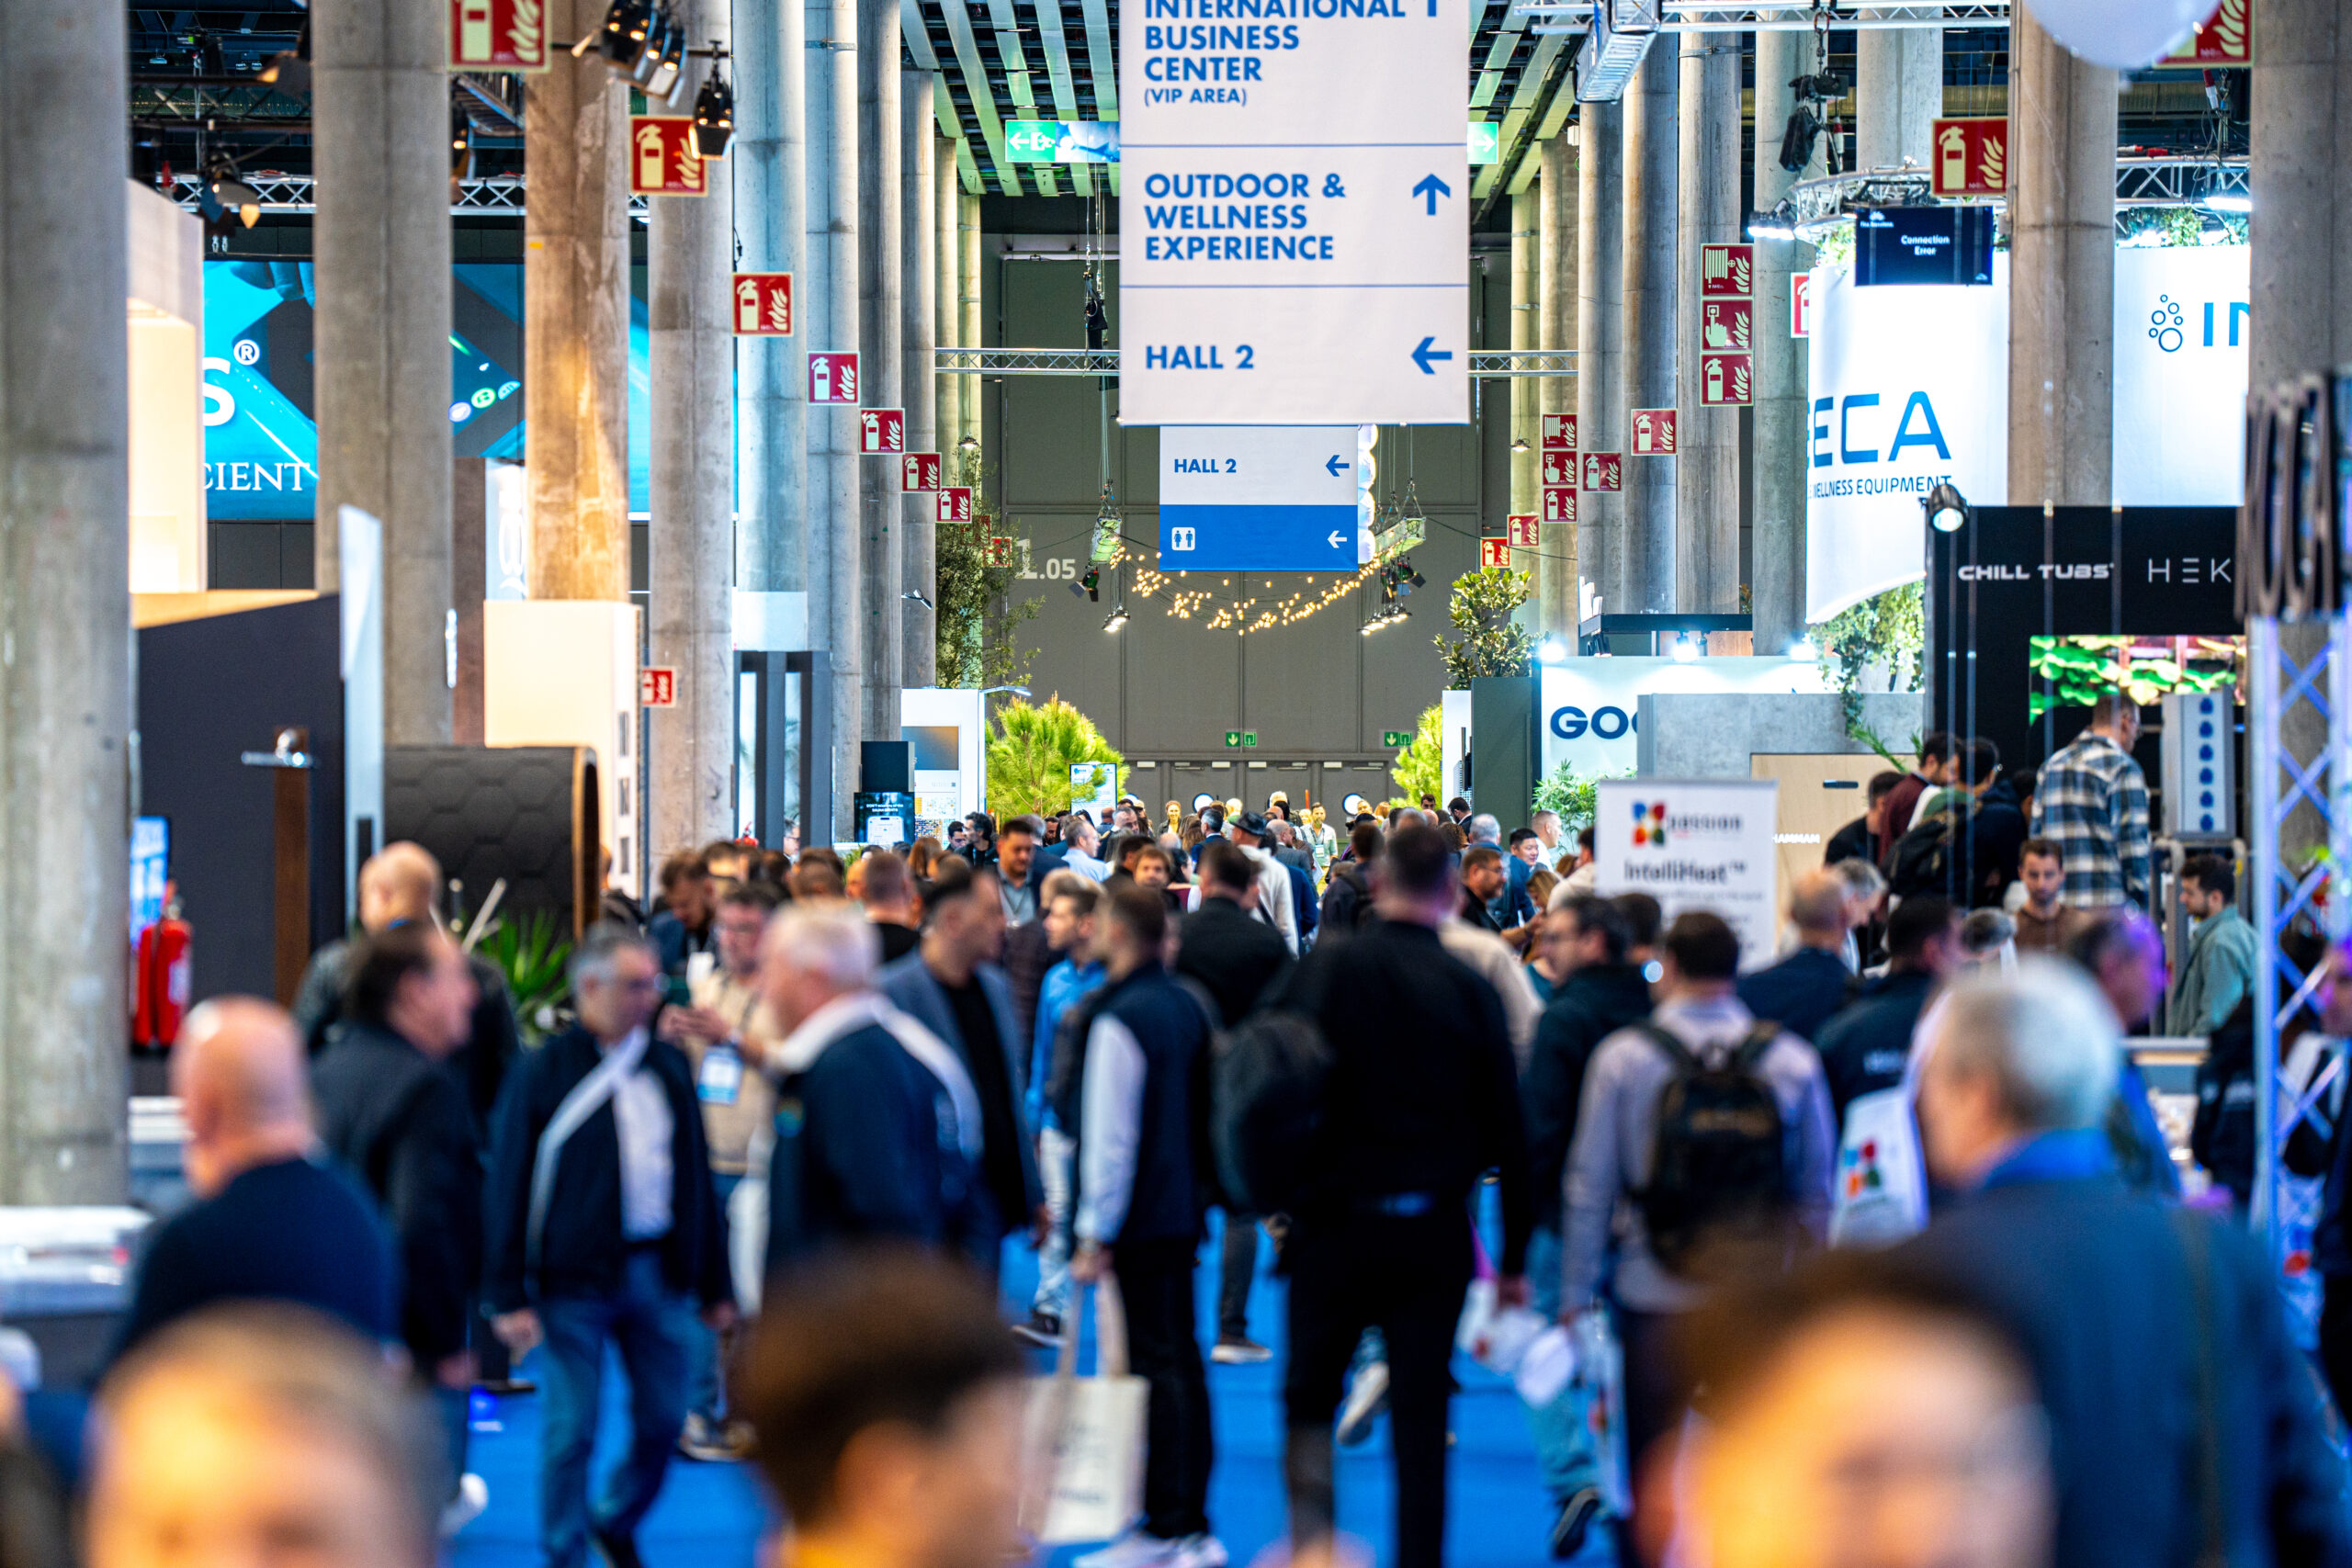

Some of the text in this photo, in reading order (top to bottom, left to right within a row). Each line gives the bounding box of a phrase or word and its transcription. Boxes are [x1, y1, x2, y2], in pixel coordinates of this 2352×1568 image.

[1145, 0, 1406, 18] INTERNATIONAL
[1145, 25, 1300, 51] BUSINESS
[1144, 56, 1262, 82] CENTER
[1144, 88, 1248, 107] (VIP AREA)
[1144, 173, 1346, 198] OUTDOOR &
[1144, 204, 1307, 230] WELLNESS
[1145, 235, 1334, 261] EXPERIENCE
[1900, 234, 1951, 245] Connection
[1914, 245, 1937, 255] Error
[1146, 344, 1254, 369] HALL 2
[1807, 390, 1951, 469] ECA
[1174, 457, 1237, 473] HALL 2
[1958, 564, 2030, 581] CHILL
[1550, 705, 1638, 739] GO
